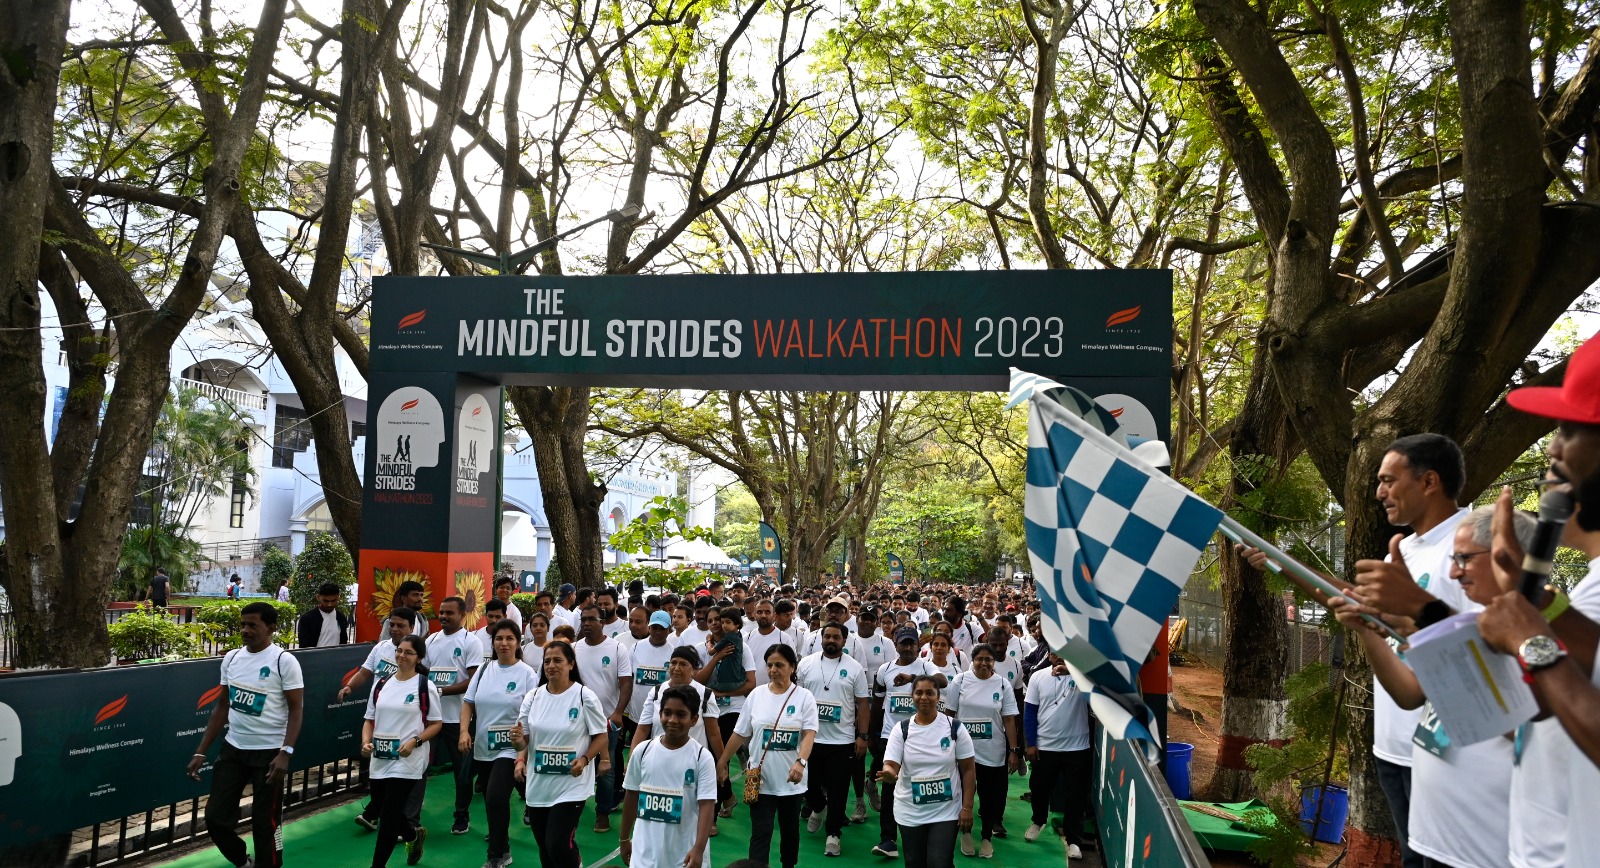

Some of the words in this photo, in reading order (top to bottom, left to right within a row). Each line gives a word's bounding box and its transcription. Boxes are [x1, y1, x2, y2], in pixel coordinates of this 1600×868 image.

[523, 288, 565, 316] THE
[457, 319, 597, 358] MINDFUL
[605, 319, 743, 359] STRIDES
[753, 317, 962, 358] WALKATHON
[974, 316, 1064, 358] 2023
[421, 343, 444, 351] Company
[1081, 343, 1109, 351] Himalaya
[1136, 344, 1164, 353] Company
[380, 454, 392, 463] THE
[377, 463, 414, 475] MINDFUL
[375, 476, 416, 491] STRIDES
[456, 478, 479, 495] STRIDES
[433, 672, 451, 682] 1400
[642, 670, 659, 681] 2451
[234, 689, 256, 706] 2178
[895, 697, 914, 708] 0482
[817, 705, 834, 717] 1272
[176, 729, 197, 737] Himalaya
[966, 723, 986, 734] 2460
[69, 747, 96, 756] Himalaya
[96, 743, 120, 751] Wellness
[120, 738, 144, 747] Company
[542, 752, 569, 767] 0585
[919, 781, 945, 796] 0639
[645, 794, 674, 813] 0648
